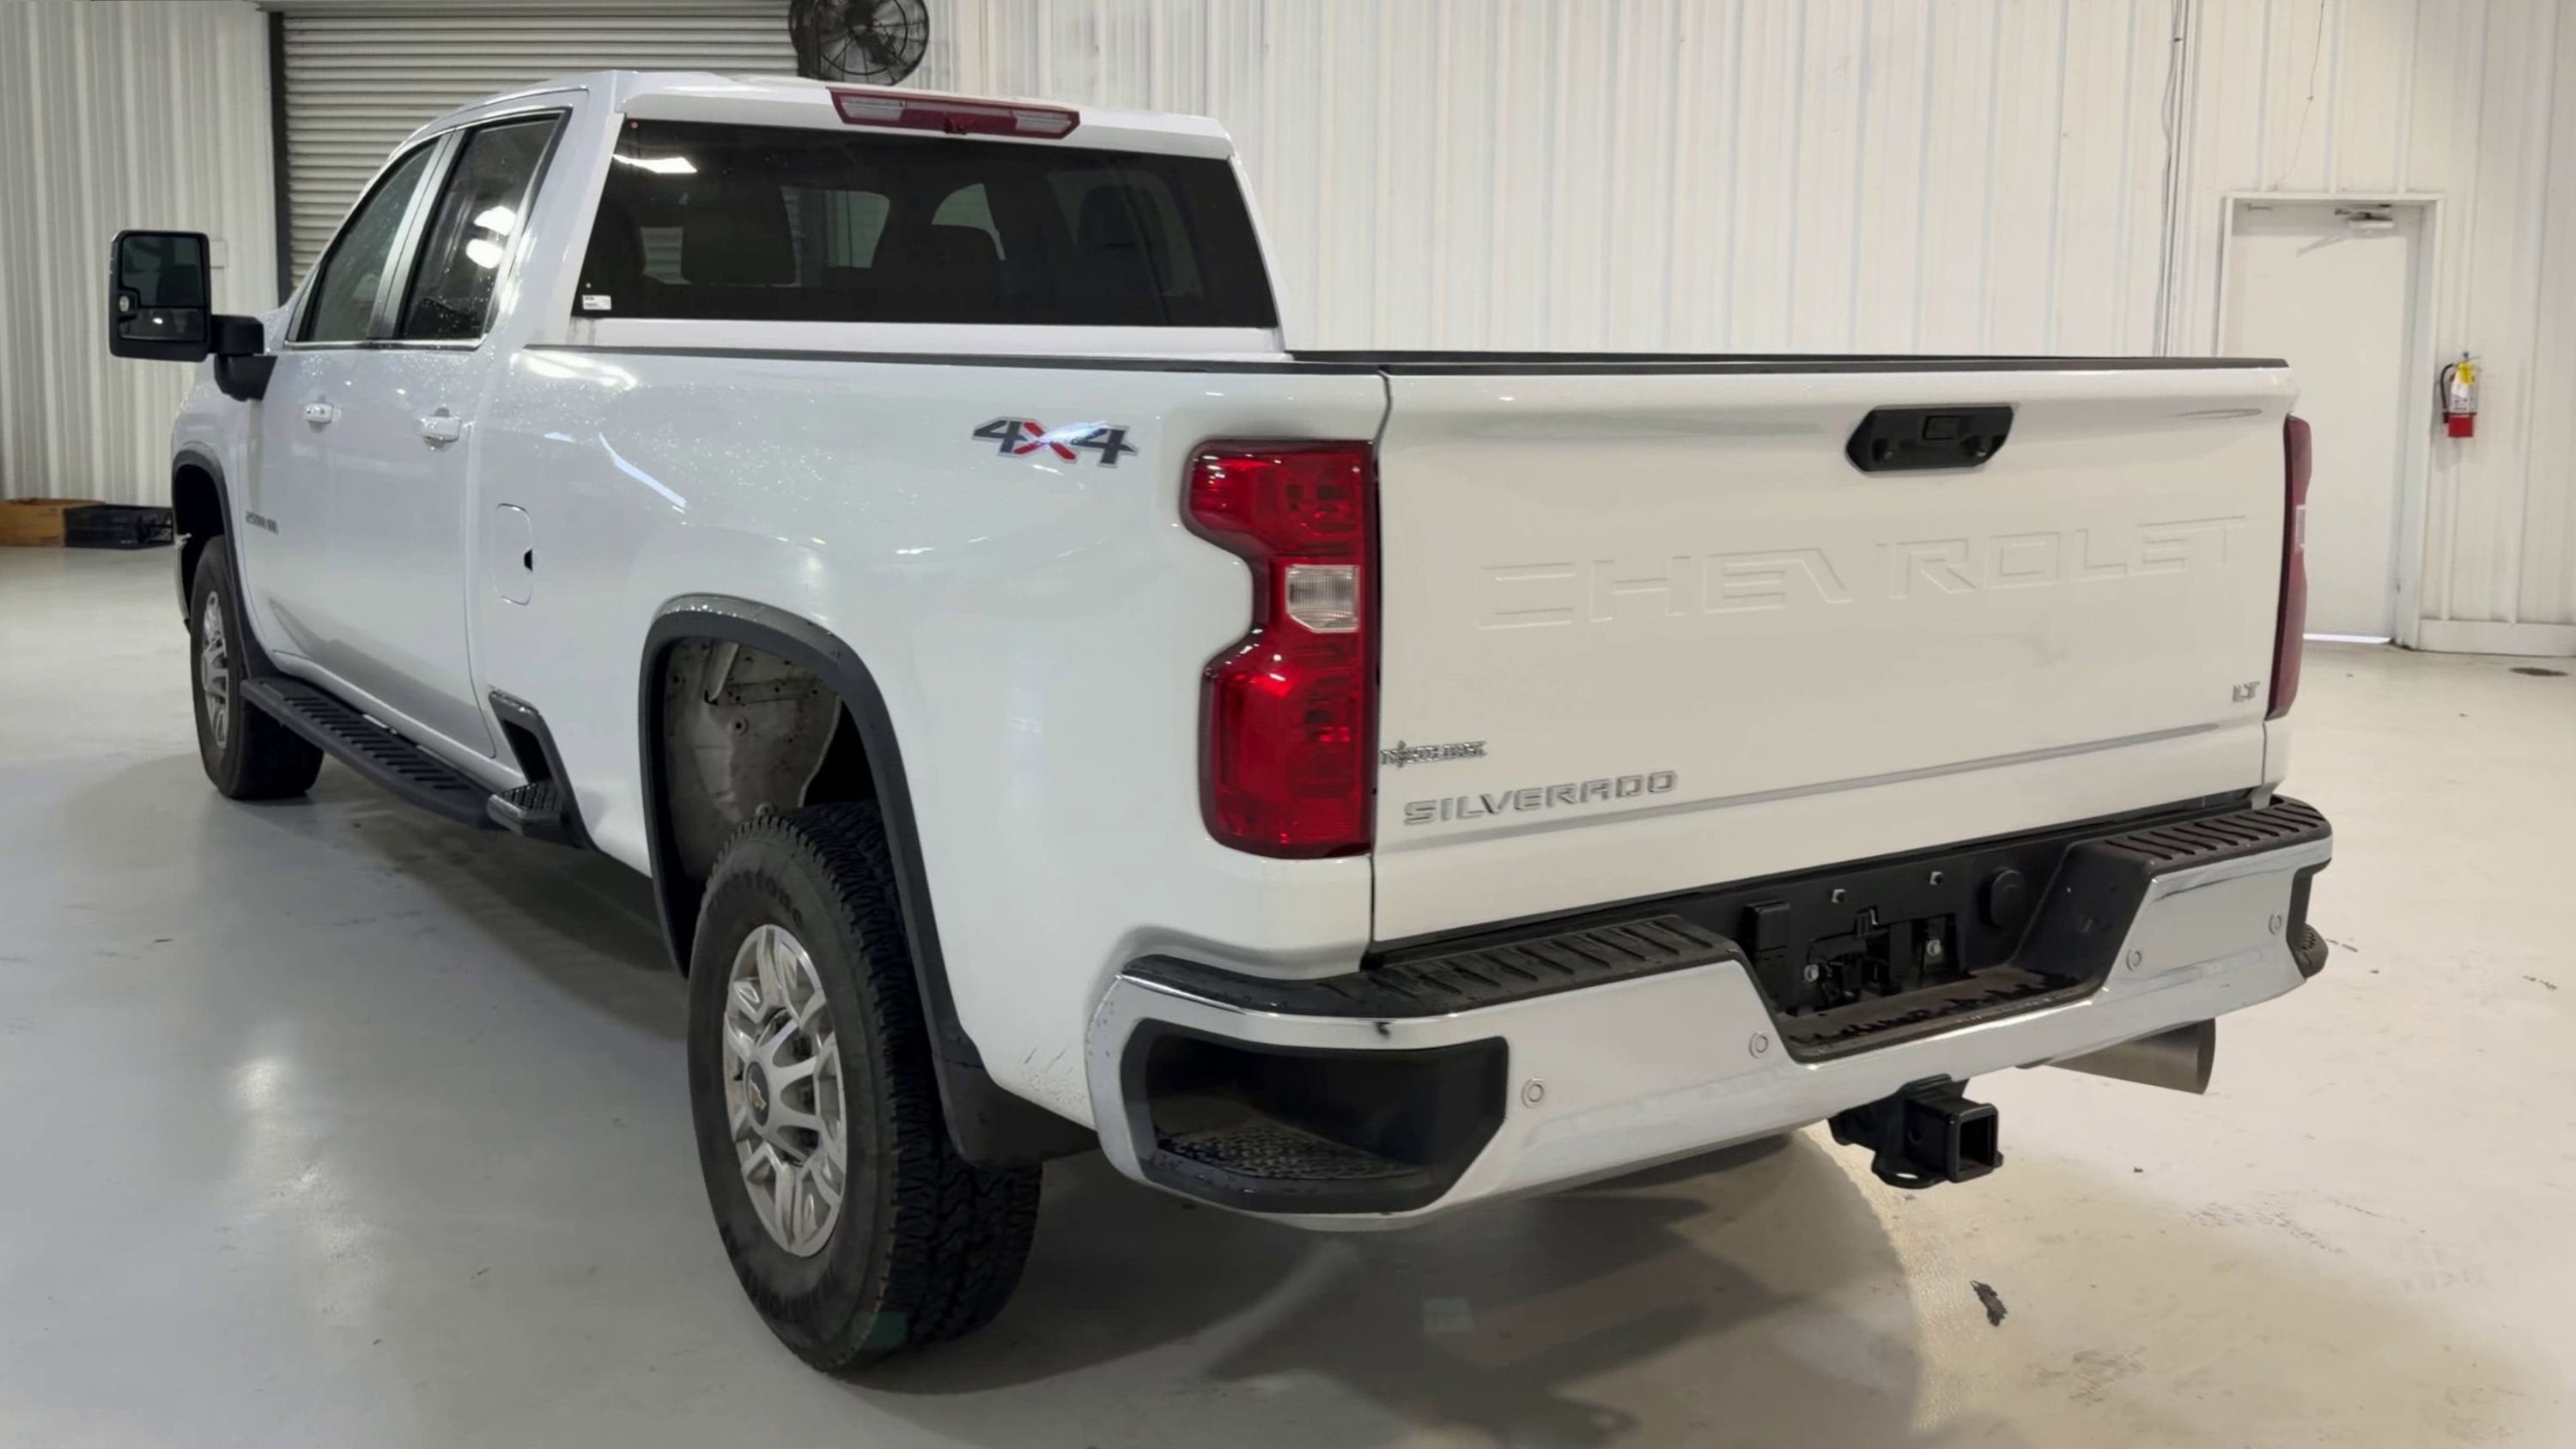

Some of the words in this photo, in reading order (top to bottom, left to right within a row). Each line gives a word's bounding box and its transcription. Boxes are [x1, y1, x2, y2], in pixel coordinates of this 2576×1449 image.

[1474, 515, 2247, 629] CHEVROLET
[2233, 681, 2261, 703] LT
[1403, 770, 1678, 826] SILVERADO
